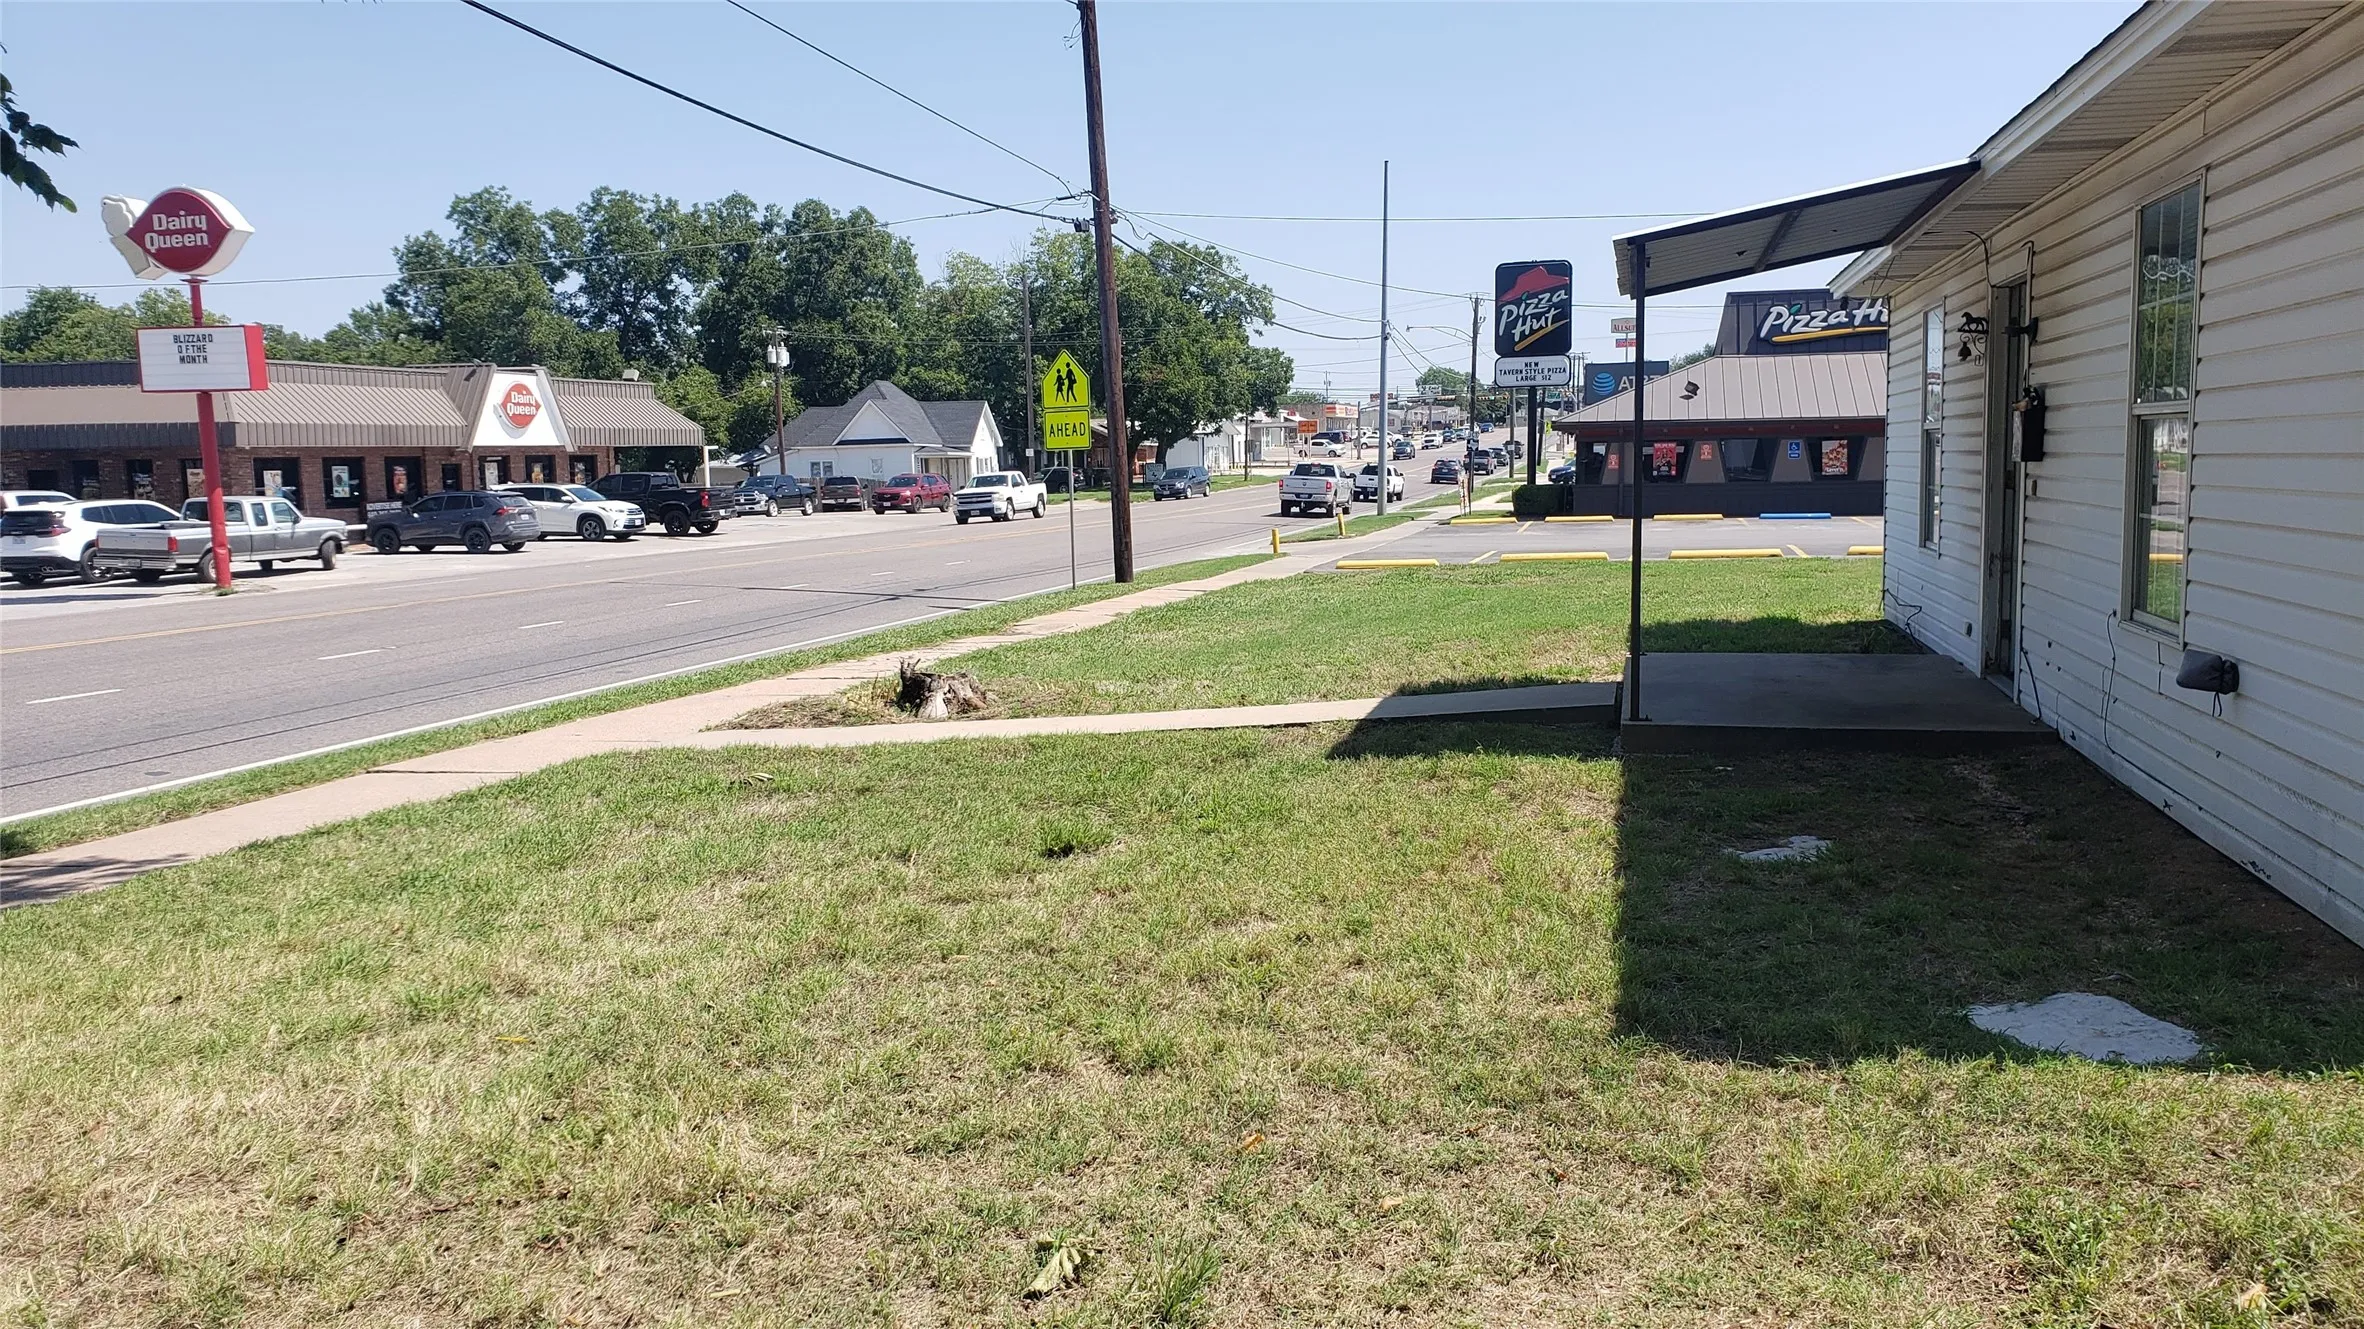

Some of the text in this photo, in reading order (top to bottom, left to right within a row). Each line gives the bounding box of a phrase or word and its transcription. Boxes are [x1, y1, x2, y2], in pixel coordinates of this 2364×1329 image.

[152, 210, 207, 230] Dairy
[144, 232, 209, 253] Queen
[1499, 290, 1569, 336] Pizza
[1760, 303, 1849, 338] Pizza
[1511, 307, 1562, 342] Hut
[173, 333, 213, 343] BLIZZARD
[179, 354, 208, 364] MONTH
[511, 390, 536, 406] Dairy
[506, 402, 536, 416] Queen
[1049, 422, 1086, 437] AHEAD
